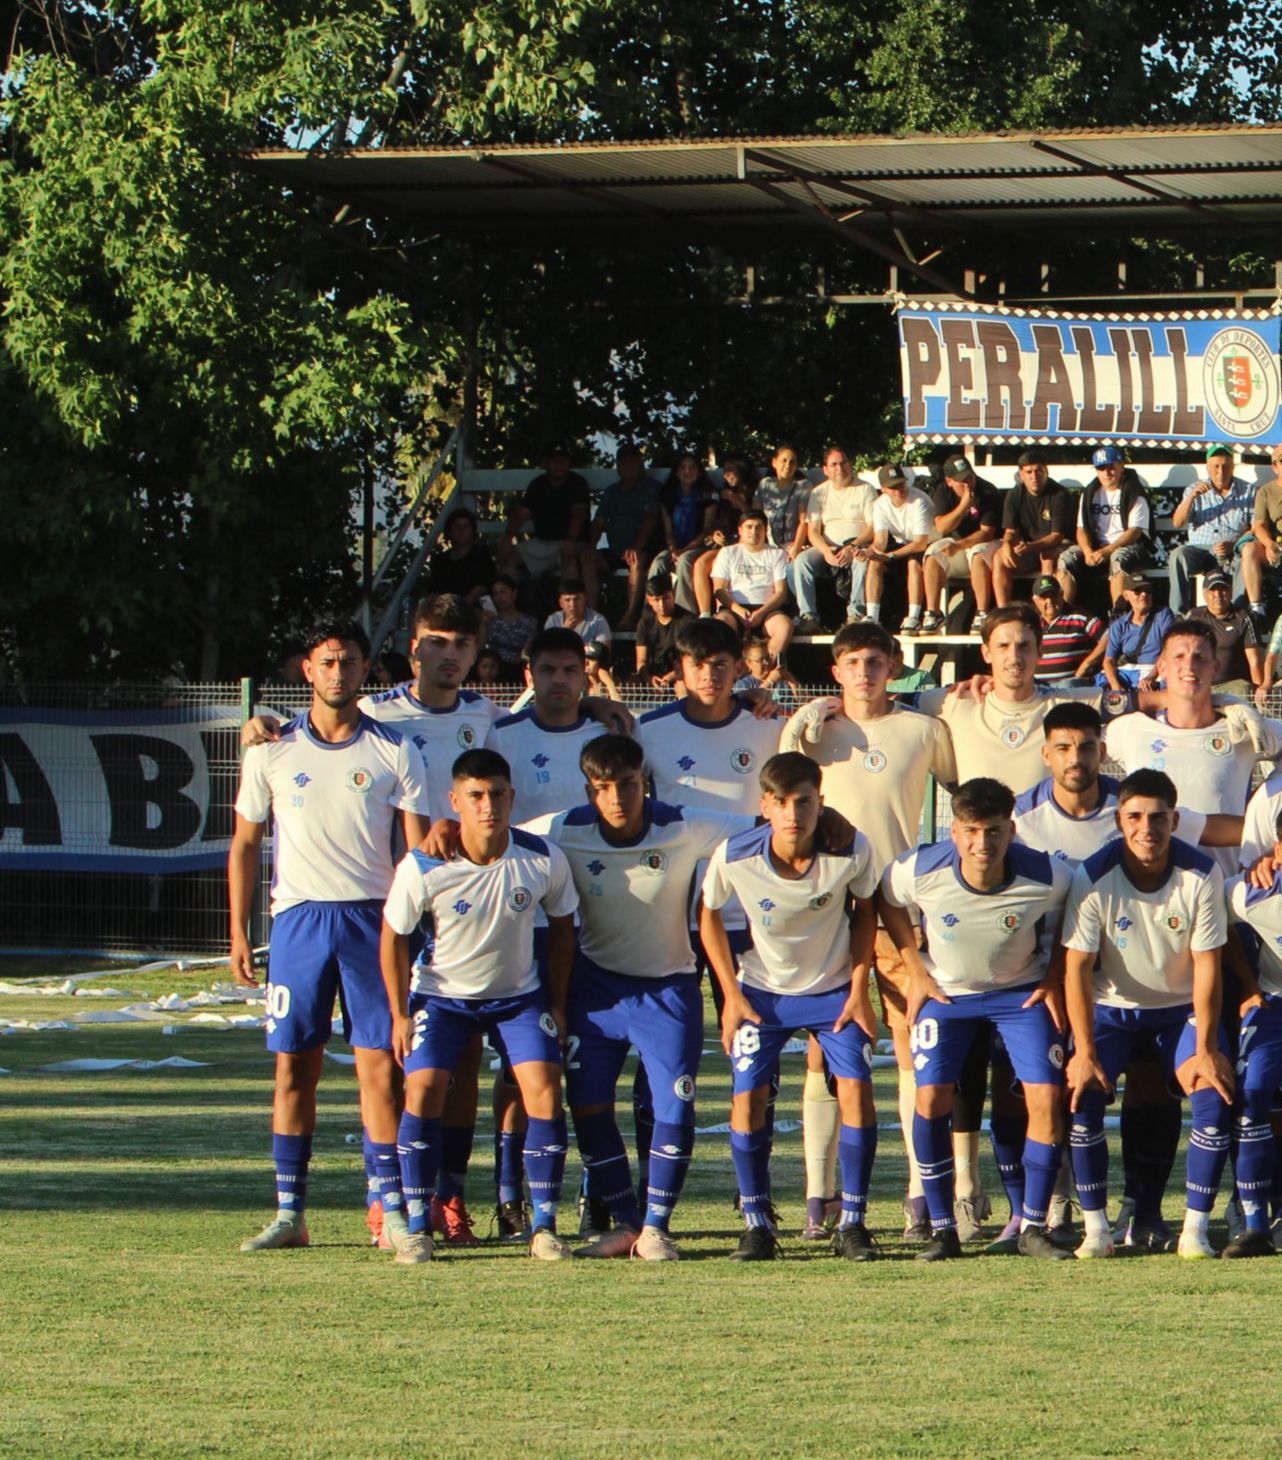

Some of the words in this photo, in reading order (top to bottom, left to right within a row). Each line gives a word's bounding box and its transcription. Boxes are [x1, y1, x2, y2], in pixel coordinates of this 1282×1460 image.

[899, 316, 1205, 437] PERALILL
[536, 770, 549, 785] 19
[290, 794, 304, 807] 30
